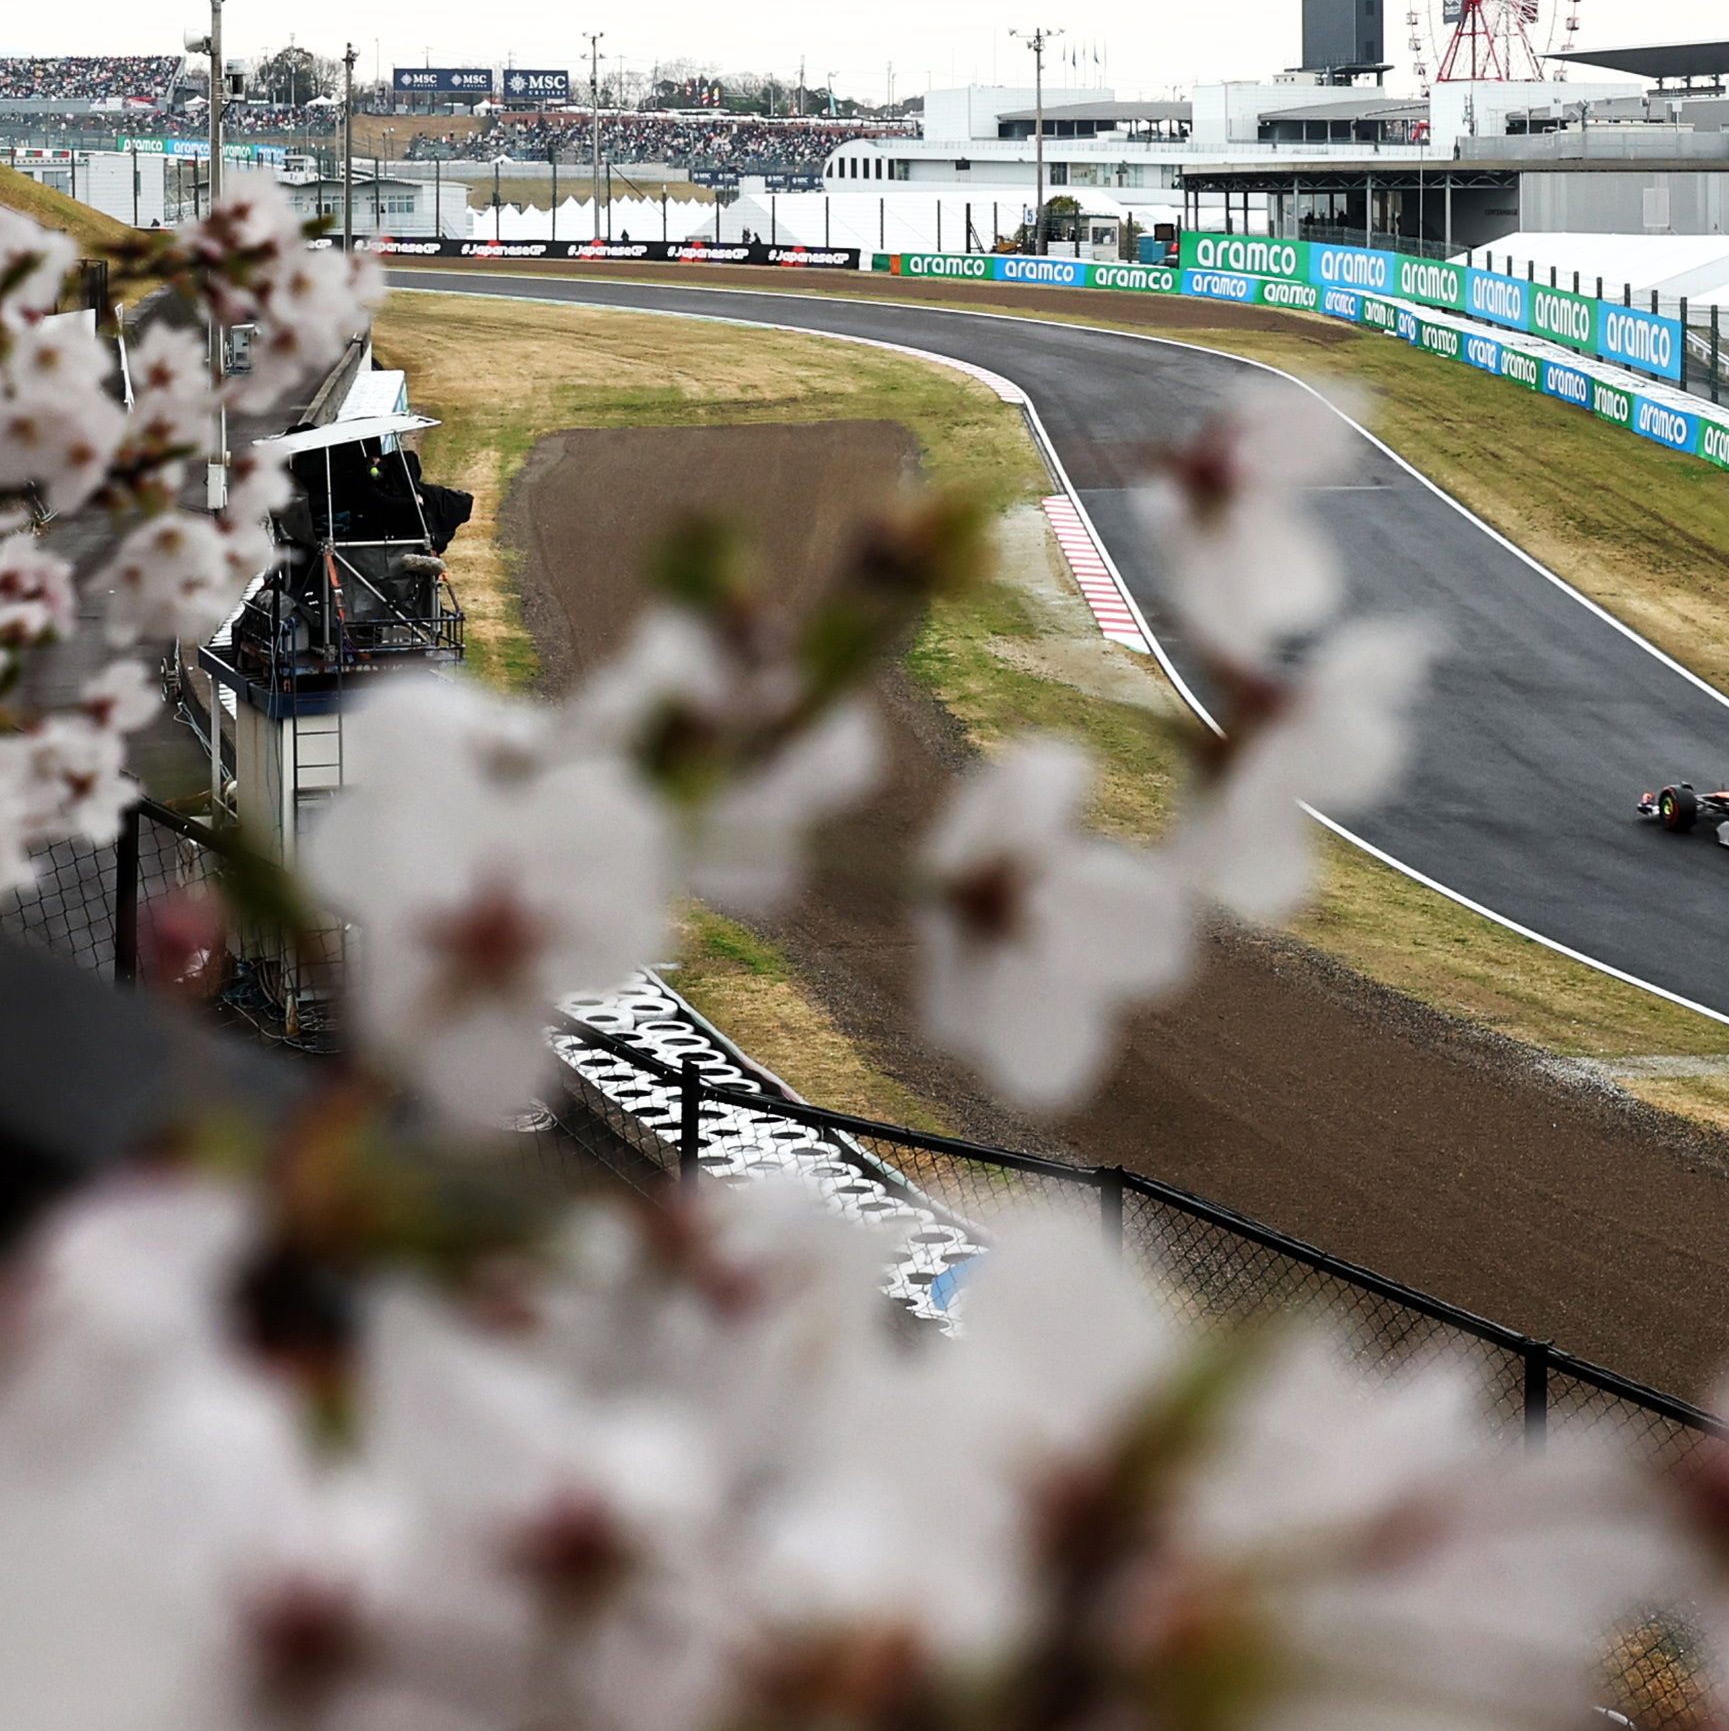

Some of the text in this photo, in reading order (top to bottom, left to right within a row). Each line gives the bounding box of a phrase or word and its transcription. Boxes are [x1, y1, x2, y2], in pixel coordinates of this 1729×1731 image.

[413, 74, 438, 84] MSC
[463, 74, 487, 84] MSC
[528, 75, 566, 89] MSC
[1027, 210, 1033, 223] 5
[910, 256, 985, 276] aramco
[1005, 259, 1074, 282] aramco
[1197, 238, 1297, 275] aramco
[1321, 250, 1385, 288] aramco
[1095, 267, 1173, 290] aramco
[1192, 273, 1248, 298] aramco
[1401, 261, 1458, 303] aramco
[1263, 282, 1316, 307] aramco
[1473, 275, 1521, 321] aramco
[1535, 291, 1590, 343] aramco
[1607, 312, 1671, 368] aramco
[1501, 351, 1537, 385] aramco
[1547, 366, 1587, 402] aramco
[1639, 403, 1687, 444] aramco
